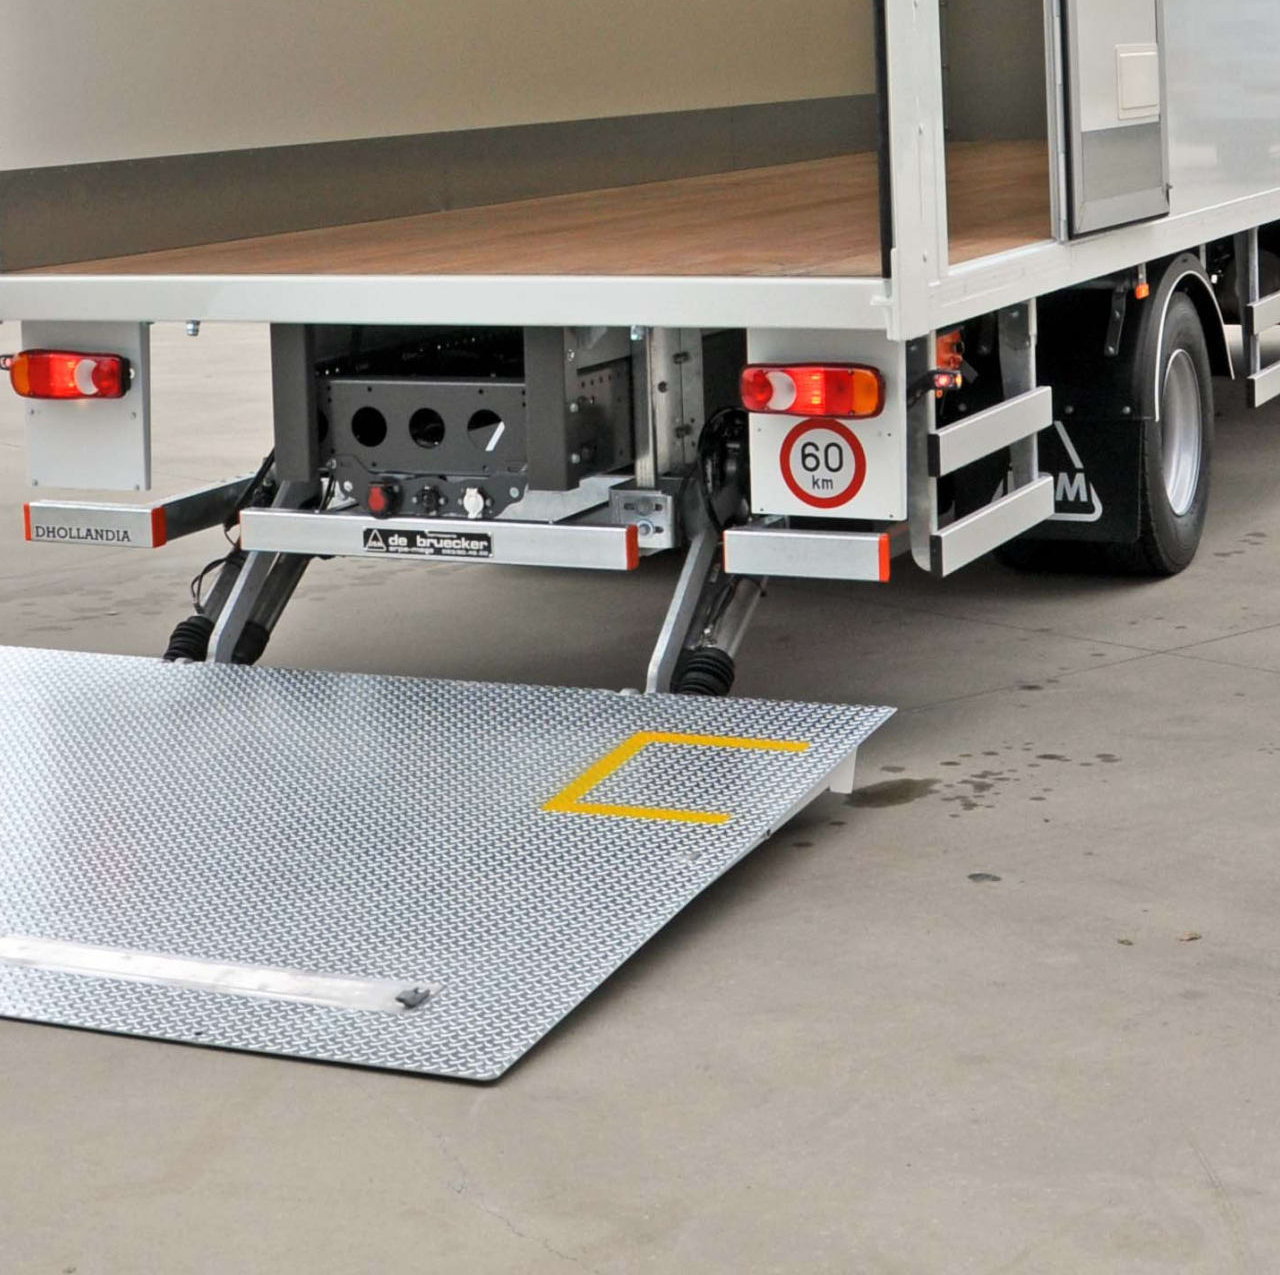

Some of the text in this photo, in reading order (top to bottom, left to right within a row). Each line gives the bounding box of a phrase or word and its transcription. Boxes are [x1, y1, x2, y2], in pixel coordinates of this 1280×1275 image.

[801, 442, 844, 472] 60
[812, 475, 834, 490] km
[34, 526, 131, 542] DHOLLANDIA
[388, 534, 489, 550] de bruecker
